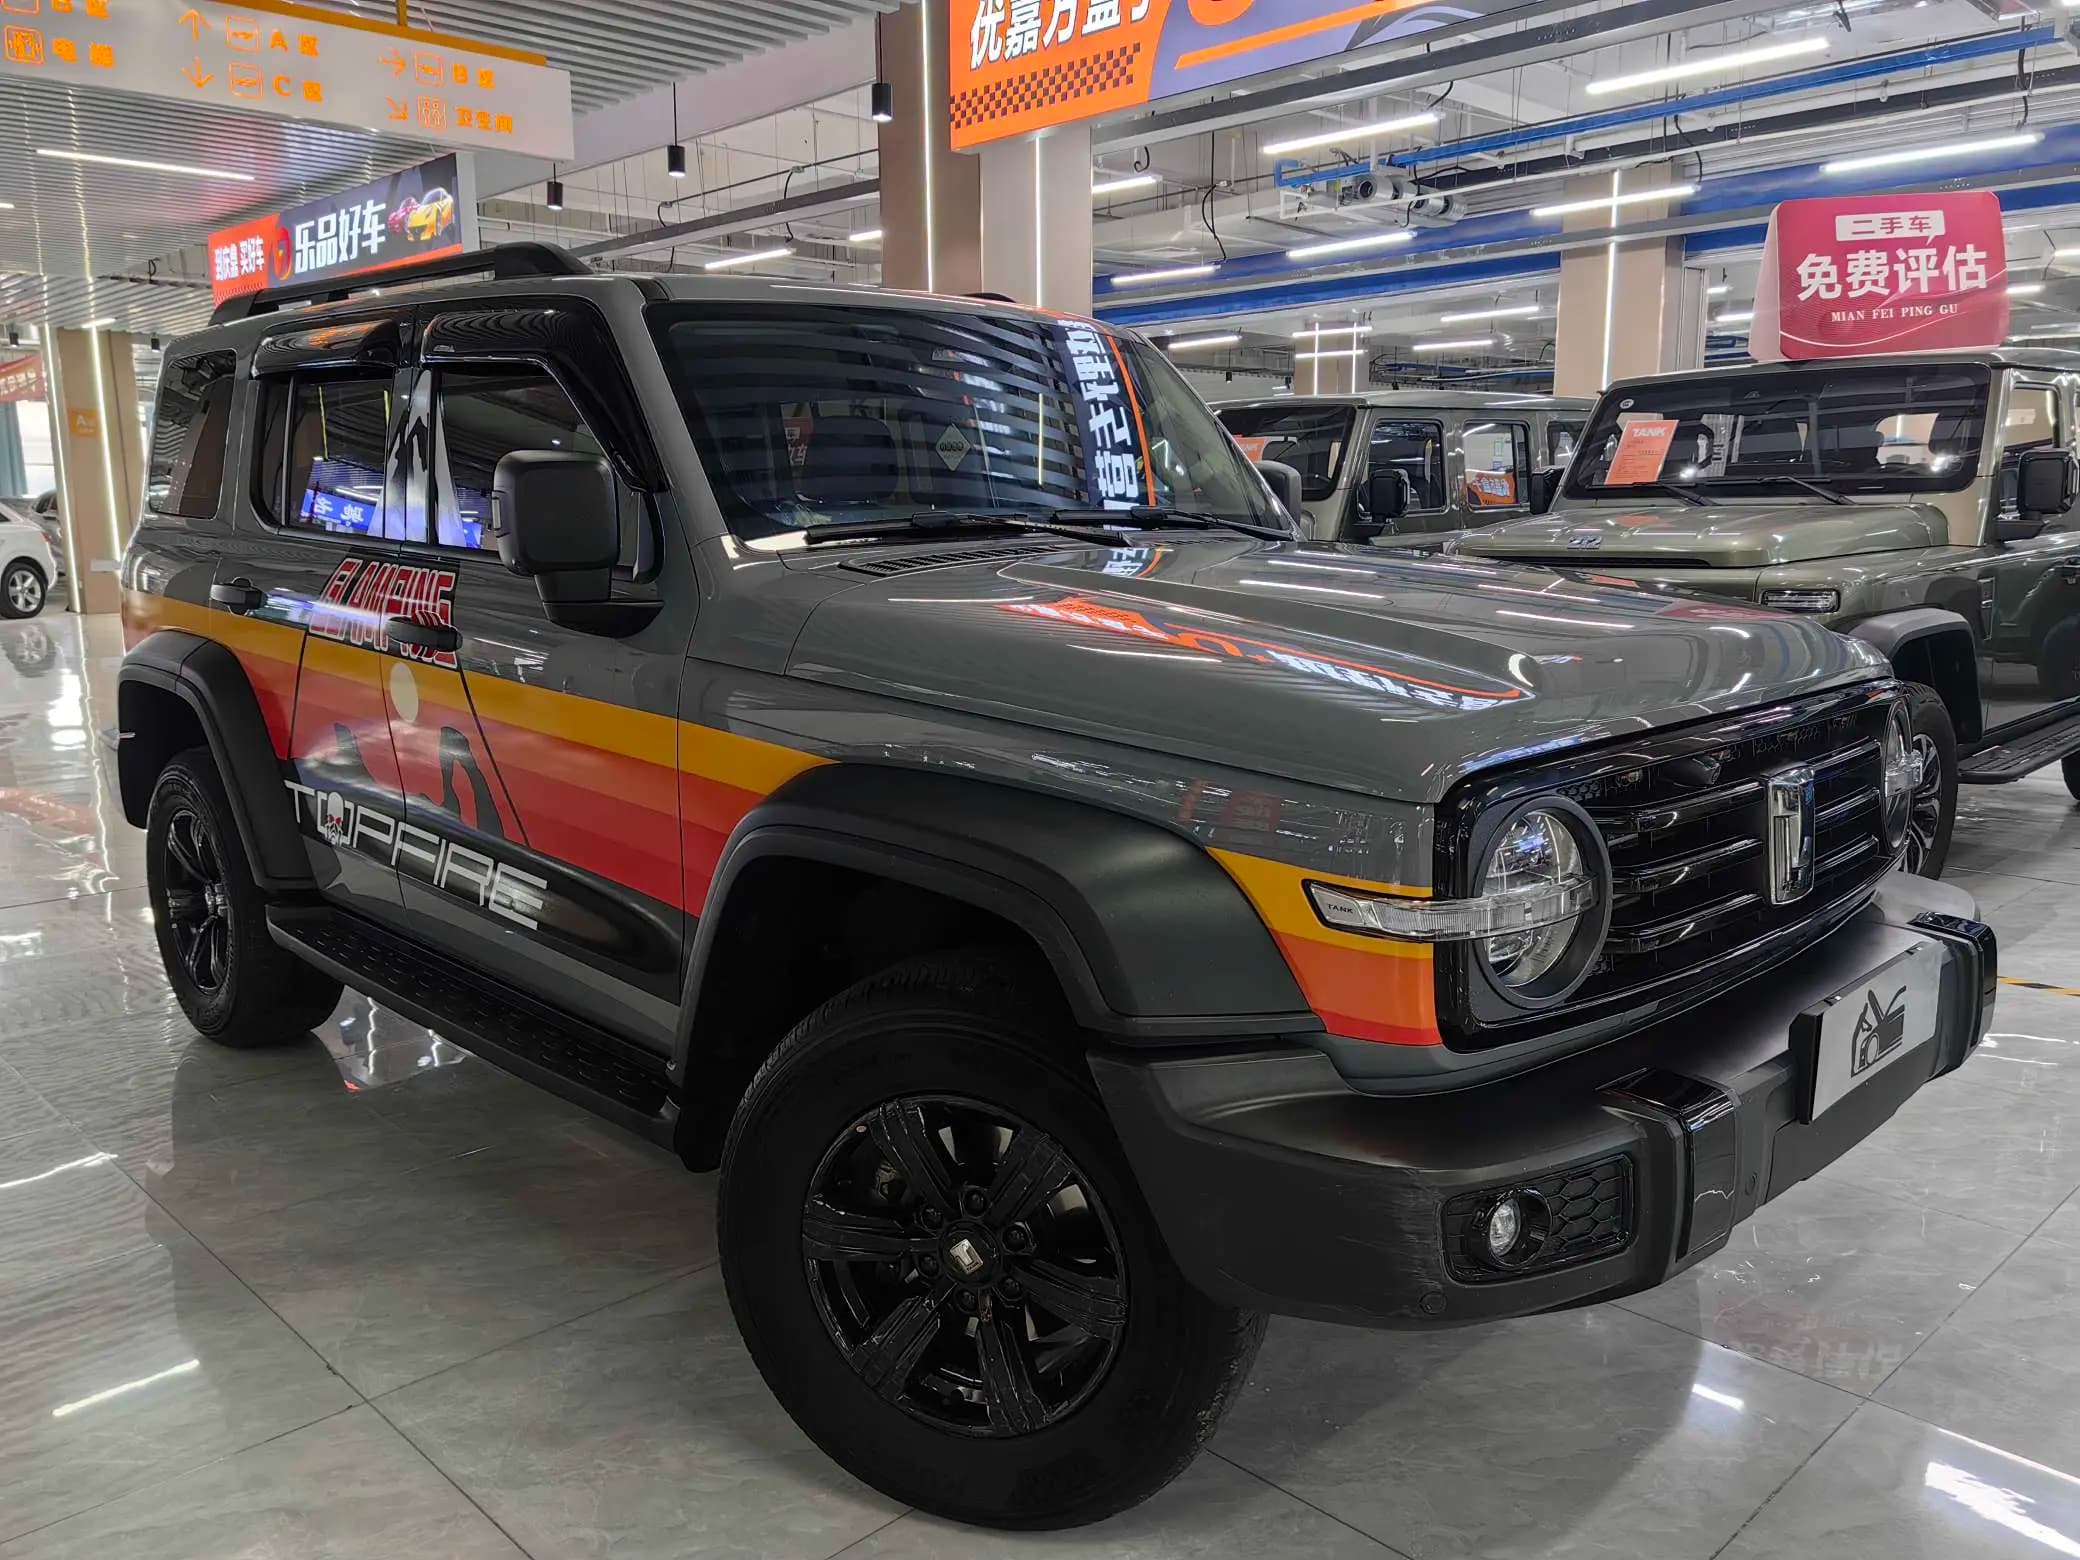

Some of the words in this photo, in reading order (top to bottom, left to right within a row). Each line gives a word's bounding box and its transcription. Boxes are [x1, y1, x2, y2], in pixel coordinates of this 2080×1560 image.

[970, 0, 1149, 70] 优嘉方
[294, 200, 387, 274] 乐品好车
[1851, 215, 1932, 235] 二手车
[1796, 243, 1988, 301] 免费评估
[1831, 310, 1865, 322] MIAN
[1872, 308, 1894, 319] FEI
[1901, 306, 1933, 316] PING
[1939, 303, 1958, 315] GU
[284, 780, 548, 931] TOPFIRE
[1328, 903, 1354, 914] TANK
